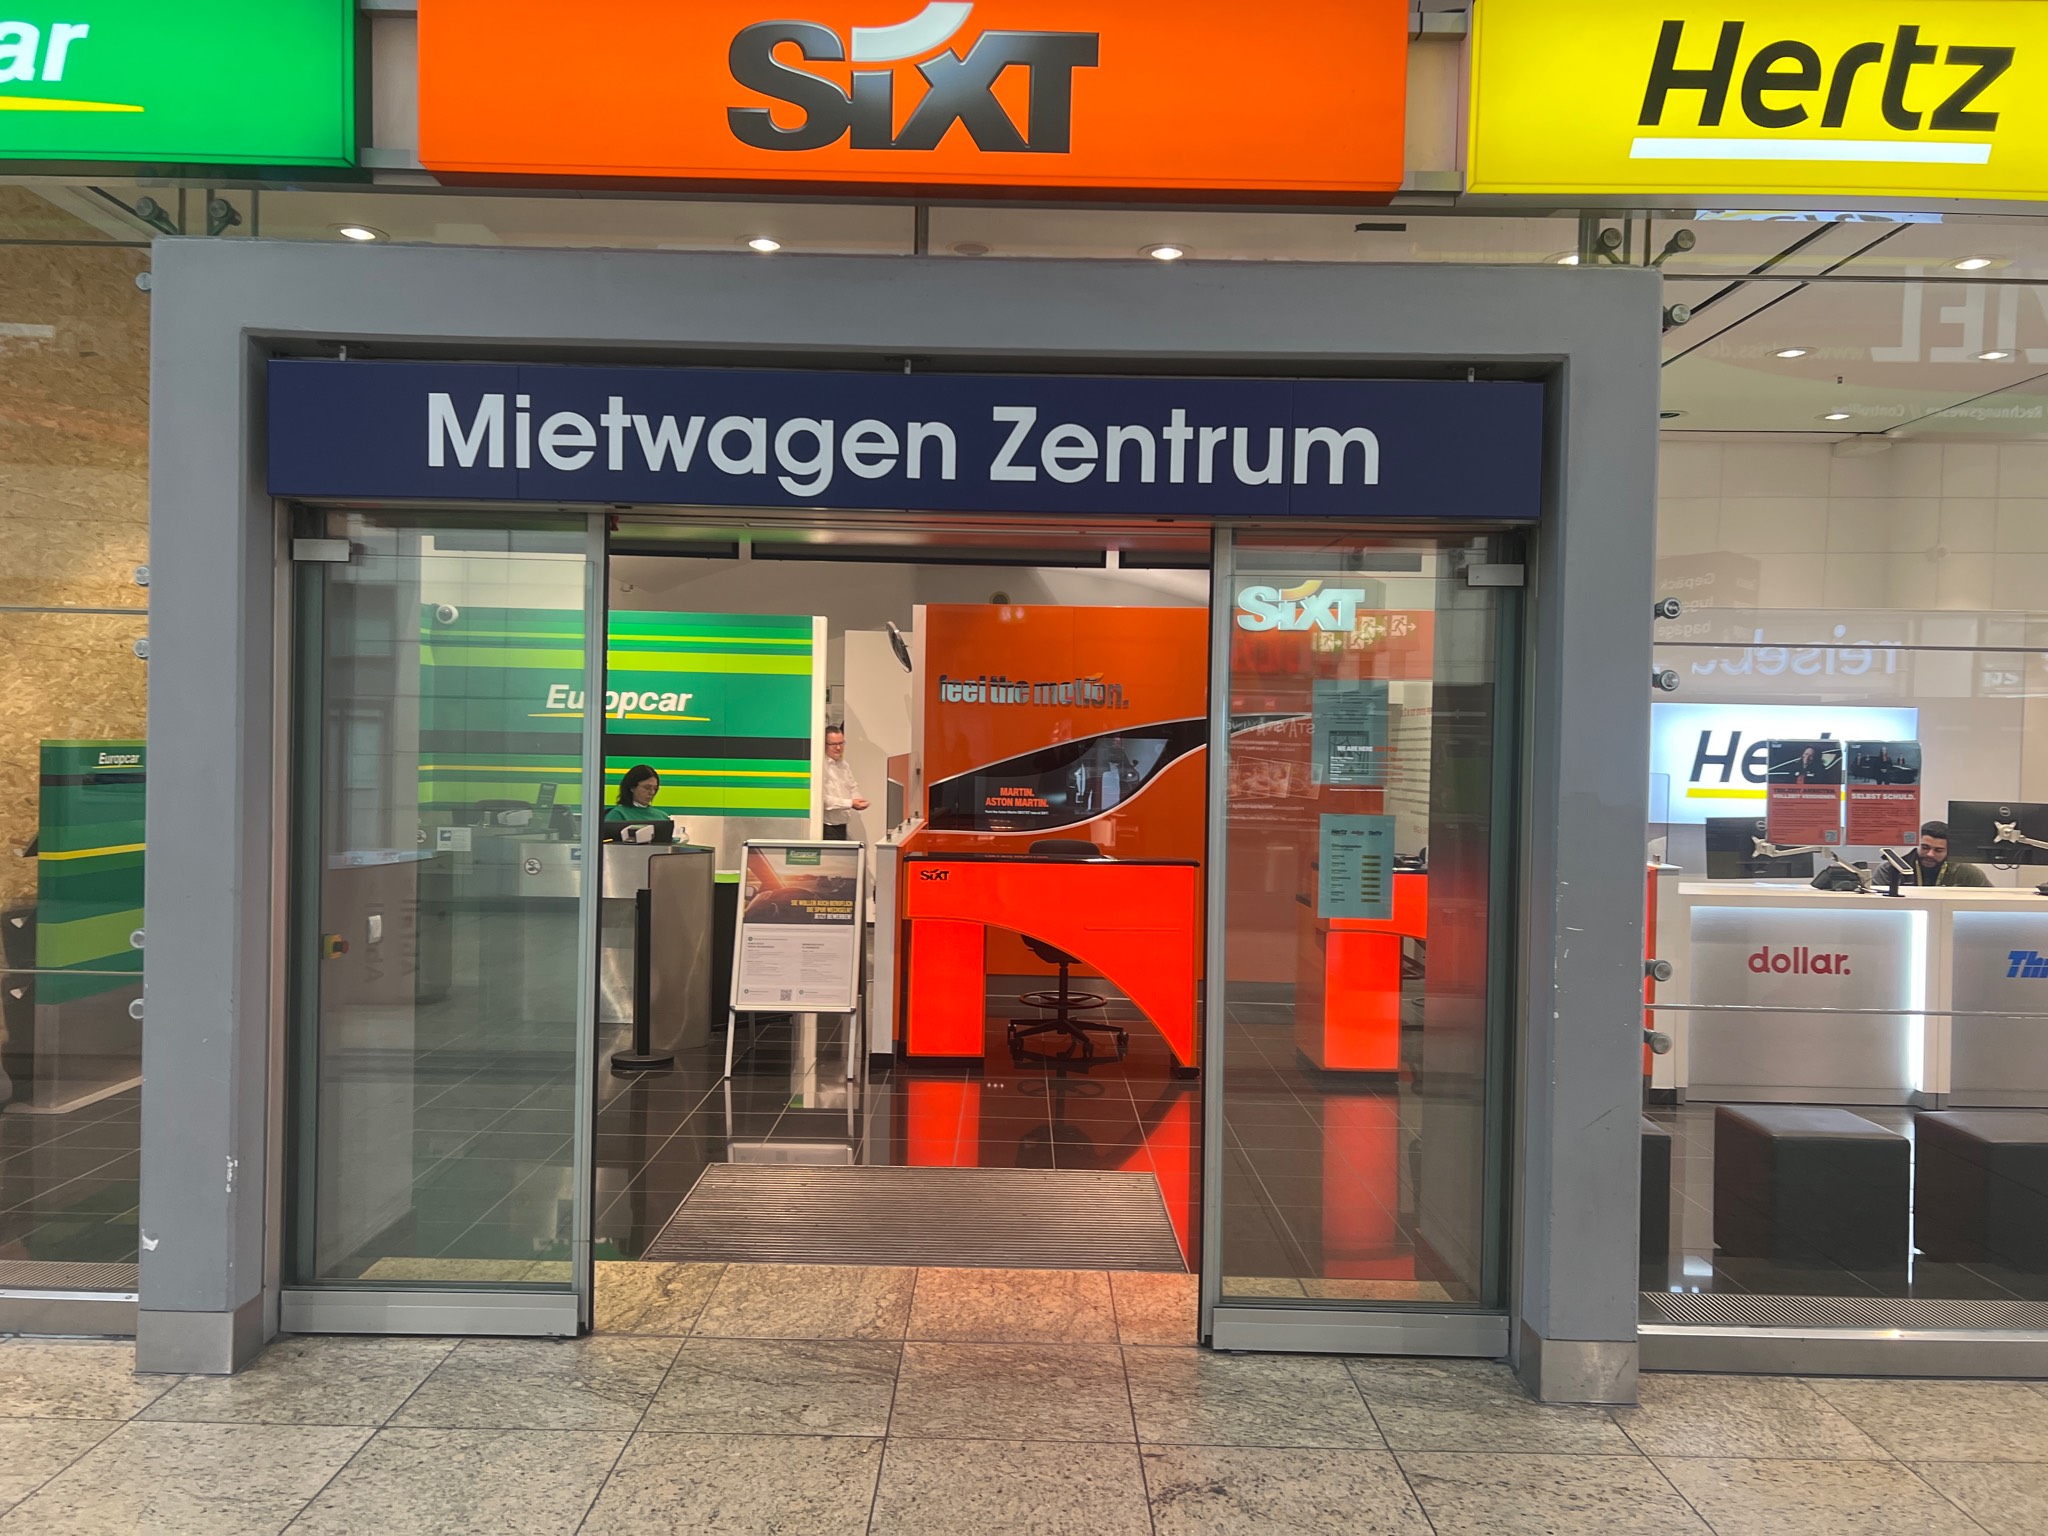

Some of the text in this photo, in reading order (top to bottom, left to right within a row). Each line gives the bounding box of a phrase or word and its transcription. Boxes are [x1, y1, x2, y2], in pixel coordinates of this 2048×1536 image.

[1638, 20, 2015, 131] Hertz
[427, 393, 1380, 497] Mietwagen Zentrum
[546, 684, 692, 718] Euopcar
[940, 675, 986, 703] feel
[990, 676, 1030, 704] the
[99, 752, 140, 767] Europcar
[985, 797, 1050, 807] ASTON MARTIN.
[1000, 787, 1035, 797] MARTIN.
[1748, 946, 1851, 975] dollar.
